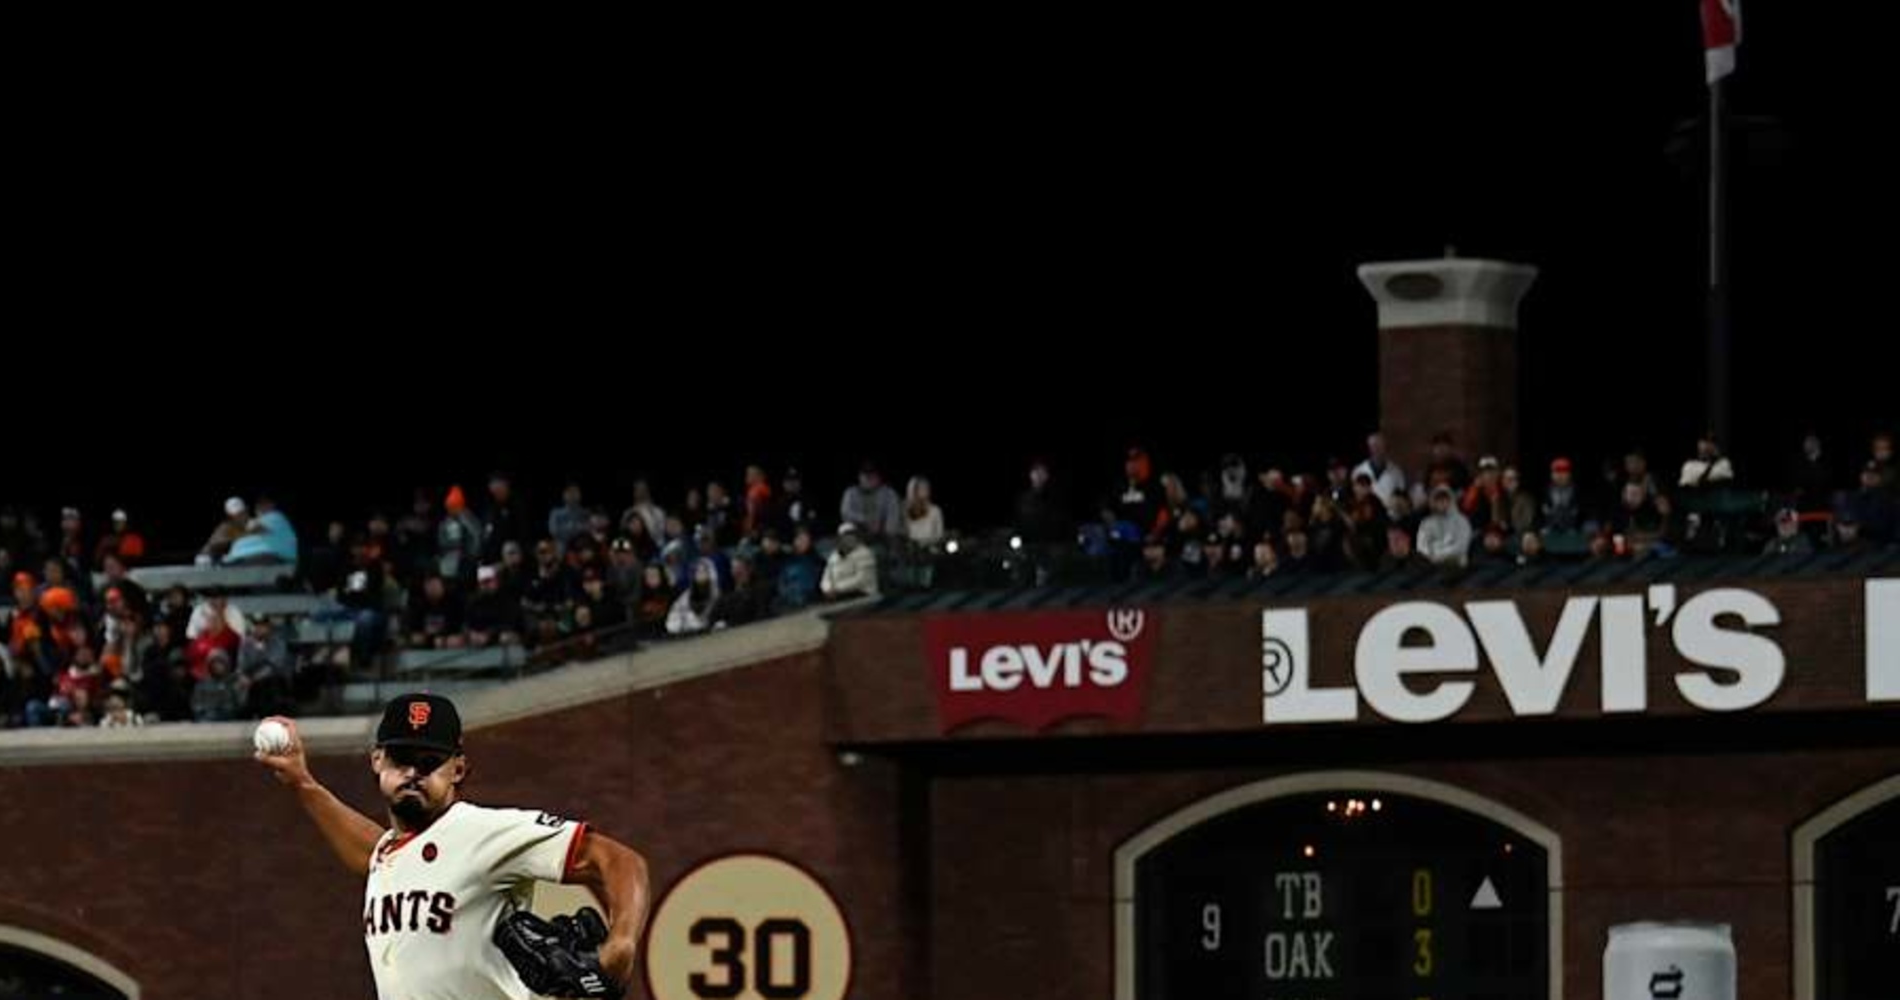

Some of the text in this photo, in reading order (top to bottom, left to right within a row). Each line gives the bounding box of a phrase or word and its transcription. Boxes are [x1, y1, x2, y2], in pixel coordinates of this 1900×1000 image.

[1274, 870, 1323, 920] TB
[1201, 902, 1222, 951] 9
[689, 918, 809, 997] 30
[1263, 926, 1433, 980] OAK 3
